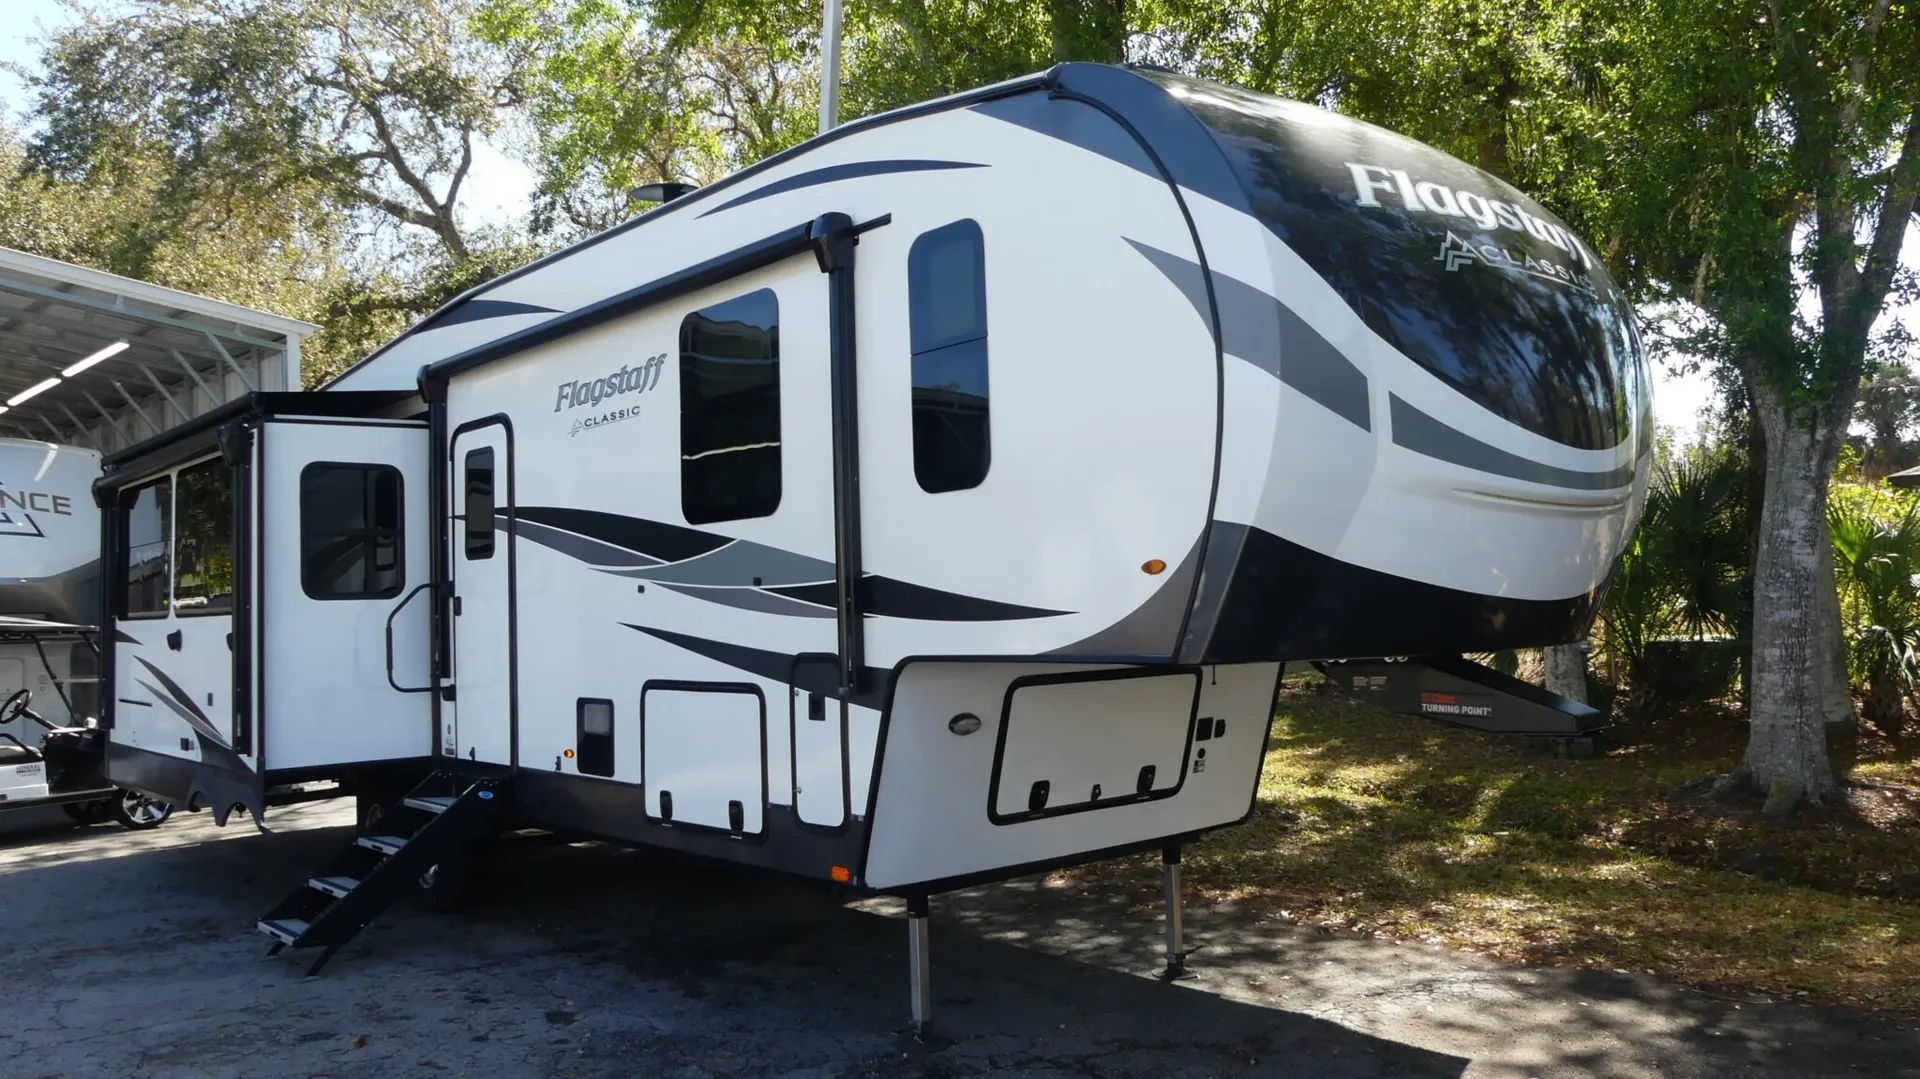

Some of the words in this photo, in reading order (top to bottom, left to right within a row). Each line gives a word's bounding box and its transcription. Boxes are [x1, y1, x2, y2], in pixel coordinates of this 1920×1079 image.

[1480, 245, 1596, 291] CLASSIC
[554, 353, 667, 413] Flagstaff
[584, 406, 640, 427] CLASSIC
[1421, 703, 1460, 714] TURNING
